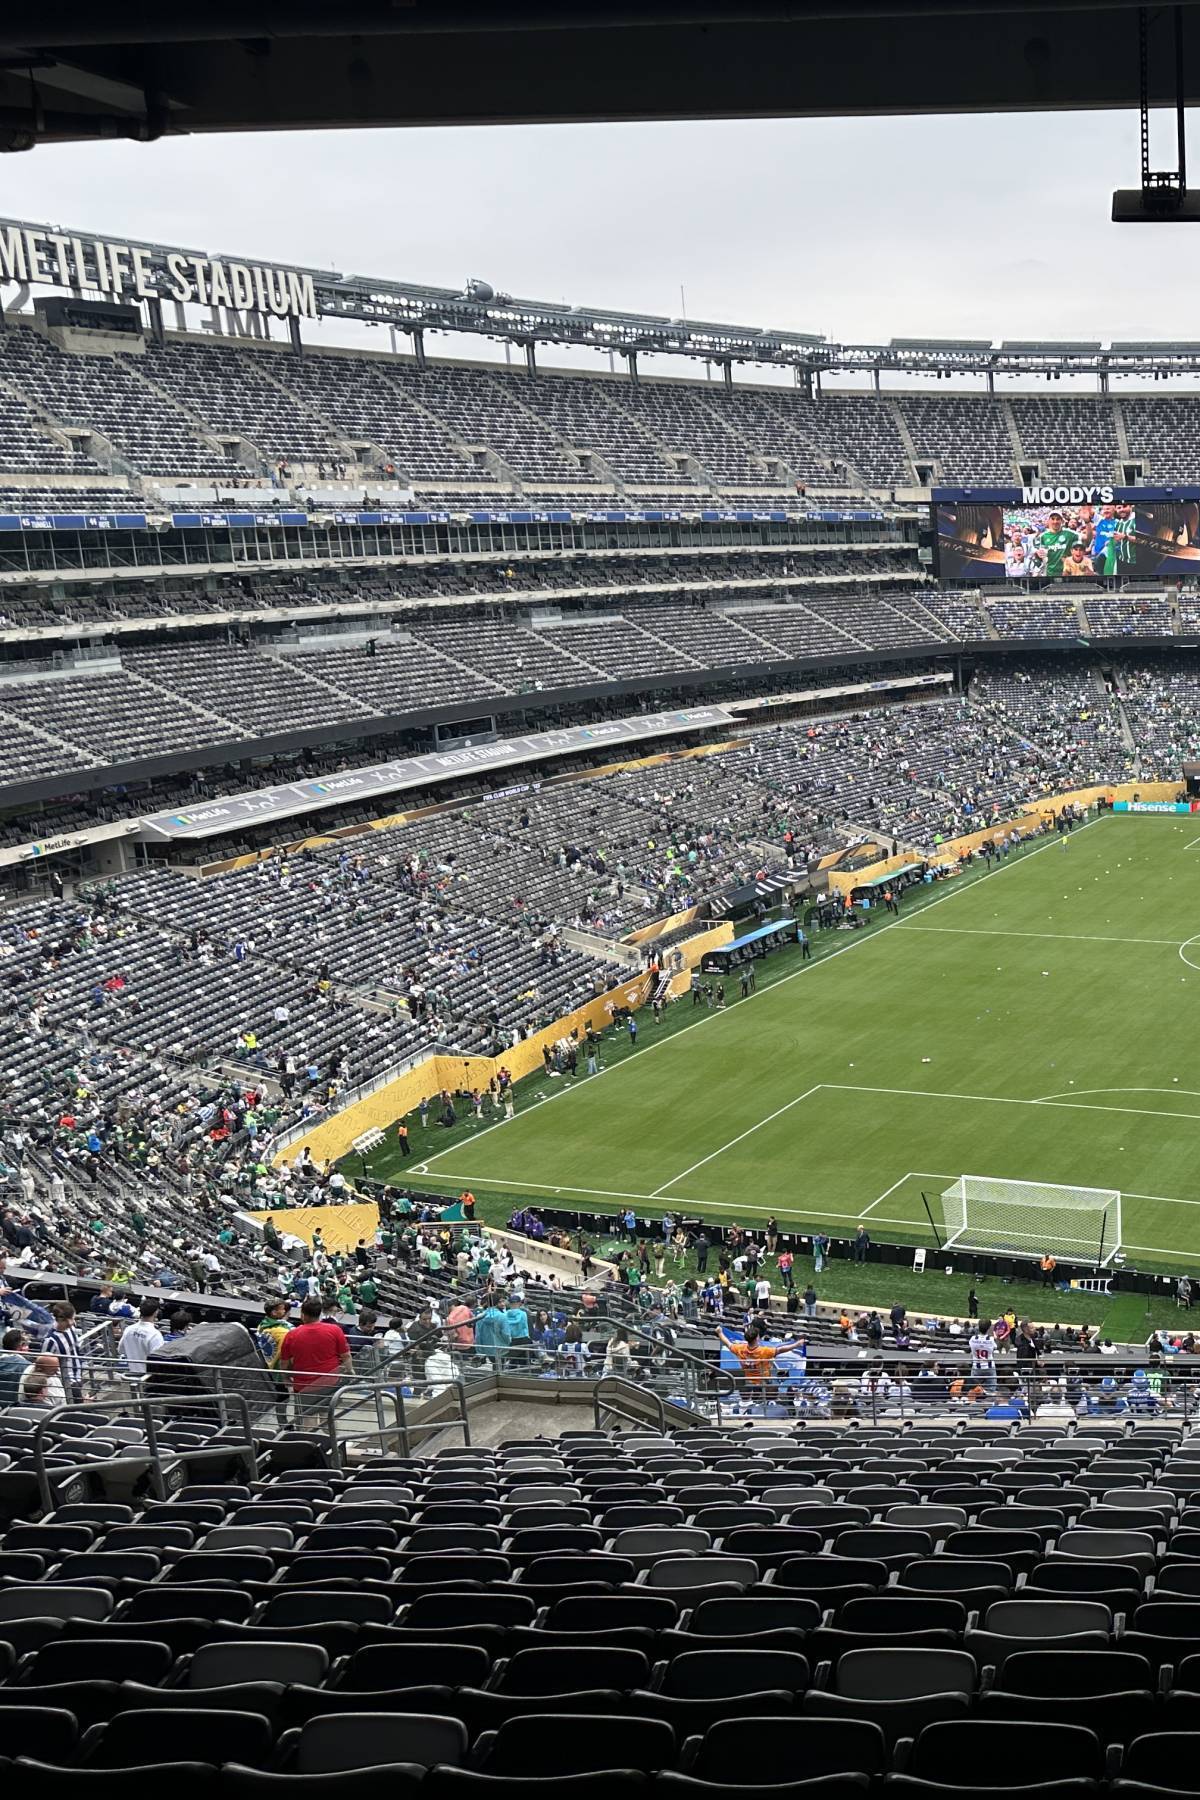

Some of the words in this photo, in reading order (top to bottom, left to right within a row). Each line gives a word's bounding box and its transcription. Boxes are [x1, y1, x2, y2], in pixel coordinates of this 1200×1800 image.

[0, 226, 159, 299] METLIFE
[166, 253, 318, 319] STADIUM
[1022, 487, 1114, 504] MOODY'S
[436, 752, 480, 767] METLIFE
[478, 743, 517, 761] STADIUM
[326, 776, 364, 791] MetLife
[188, 807, 231, 824] MetLife
[1127, 802, 1177, 812] Hisense
[44, 838, 71, 851] MetLife
